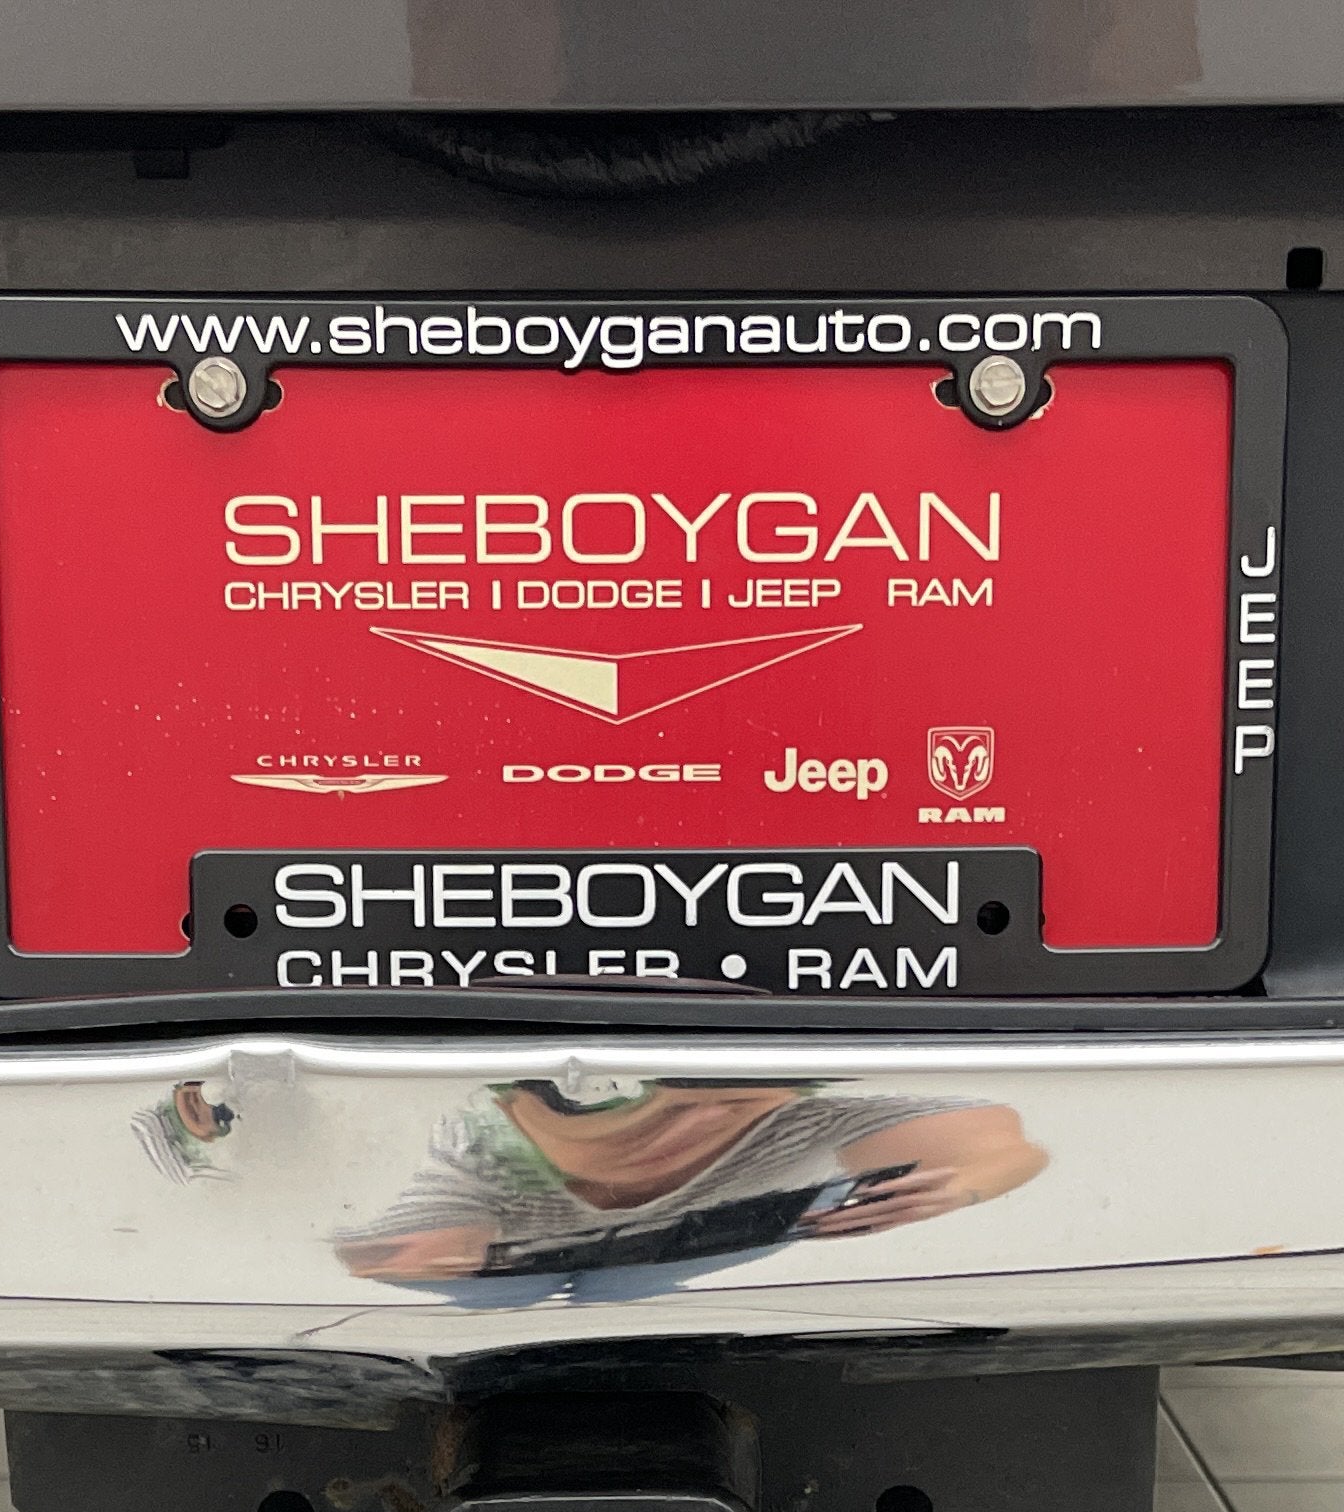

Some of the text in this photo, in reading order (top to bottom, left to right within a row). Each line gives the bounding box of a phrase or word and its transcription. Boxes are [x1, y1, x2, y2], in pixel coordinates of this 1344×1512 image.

[116, 306, 1102, 368] www.sheboyganauto.com
[225, 492, 1000, 565] SHEBOYGAN
[225, 581, 469, 610] CHRYSLER
[518, 580, 682, 608] DODGE
[728, 579, 841, 607] JEEP
[888, 578, 992, 606] RAM
[1235, 527, 1276, 774] JEEP
[257, 755, 420, 767] CHRYSLER
[503, 764, 721, 782] DODGE
[764, 748, 888, 799] Jeep
[919, 807, 1005, 823] RAM
[275, 862, 958, 927] SHEBOYGAN
[789, 947, 957, 989] RAM
